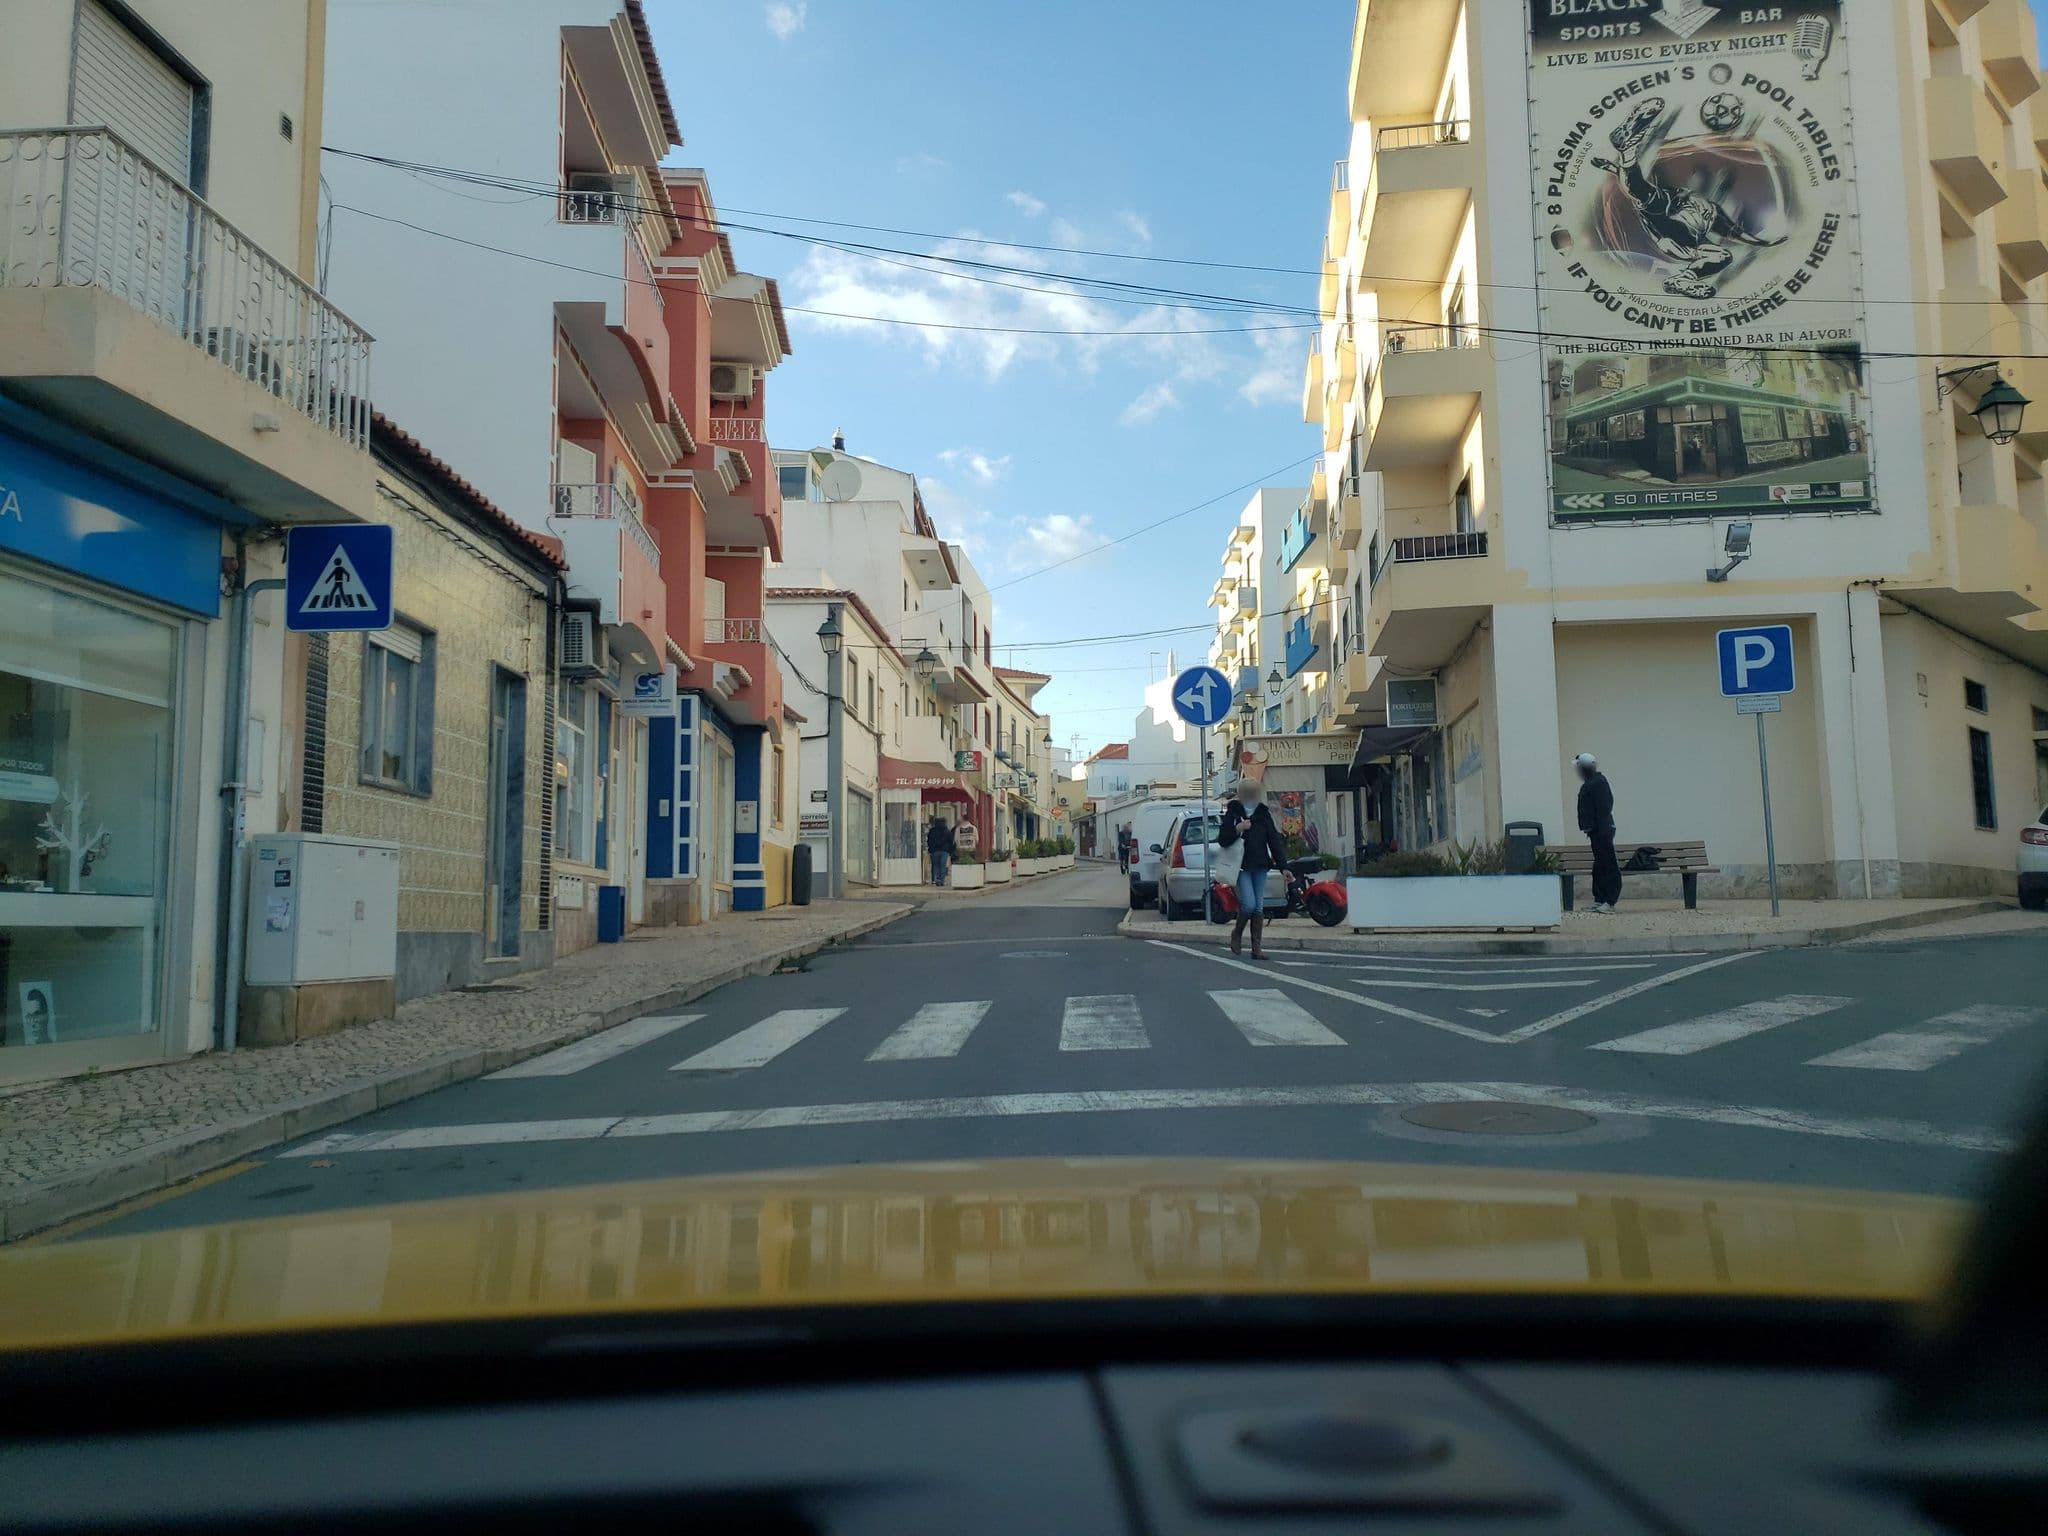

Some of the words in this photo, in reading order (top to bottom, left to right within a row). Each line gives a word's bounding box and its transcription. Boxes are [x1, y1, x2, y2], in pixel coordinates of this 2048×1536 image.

[1560, 22, 1641, 41] SPORTS
[1741, 8, 1782, 24] BAR
[1547, 52, 1588, 67] LIVE
[1594, 46, 1653, 63] MUSIC
[1660, 40, 1722, 57] EVERY
[1728, 33, 1788, 50] NIGHT
[1741, 73, 1795, 112] POOL
[1796, 107, 1841, 181] TABLES
[1547, 121, 1592, 197] PLASMA
[1547, 203, 1562, 216] 8
[1567, 262, 1589, 279] IF
[1585, 278, 1622, 312] YOU
[1624, 306, 1684, 333] CAN'T
[1690, 317, 1717, 334] BE
[1720, 290, 1787, 329] THERE
[1784, 268, 1813, 295] BE
[1804, 212, 1841, 270] HERE!
[1556, 344, 1583, 355] THE
[1587, 341, 1643, 353] BIGGEST
[1649, 338, 1686, 350] IRISH
[1690, 335, 1741, 347] OWNED
[1746, 333, 1774, 345] BAR
[1779, 331, 1794, 343] IN
[1799, 328, 1852, 342] ALVOR!
[0, 486, 23, 522] A
[1645, 490, 1718, 504] METRES
[1734, 635, 1775, 689] P
